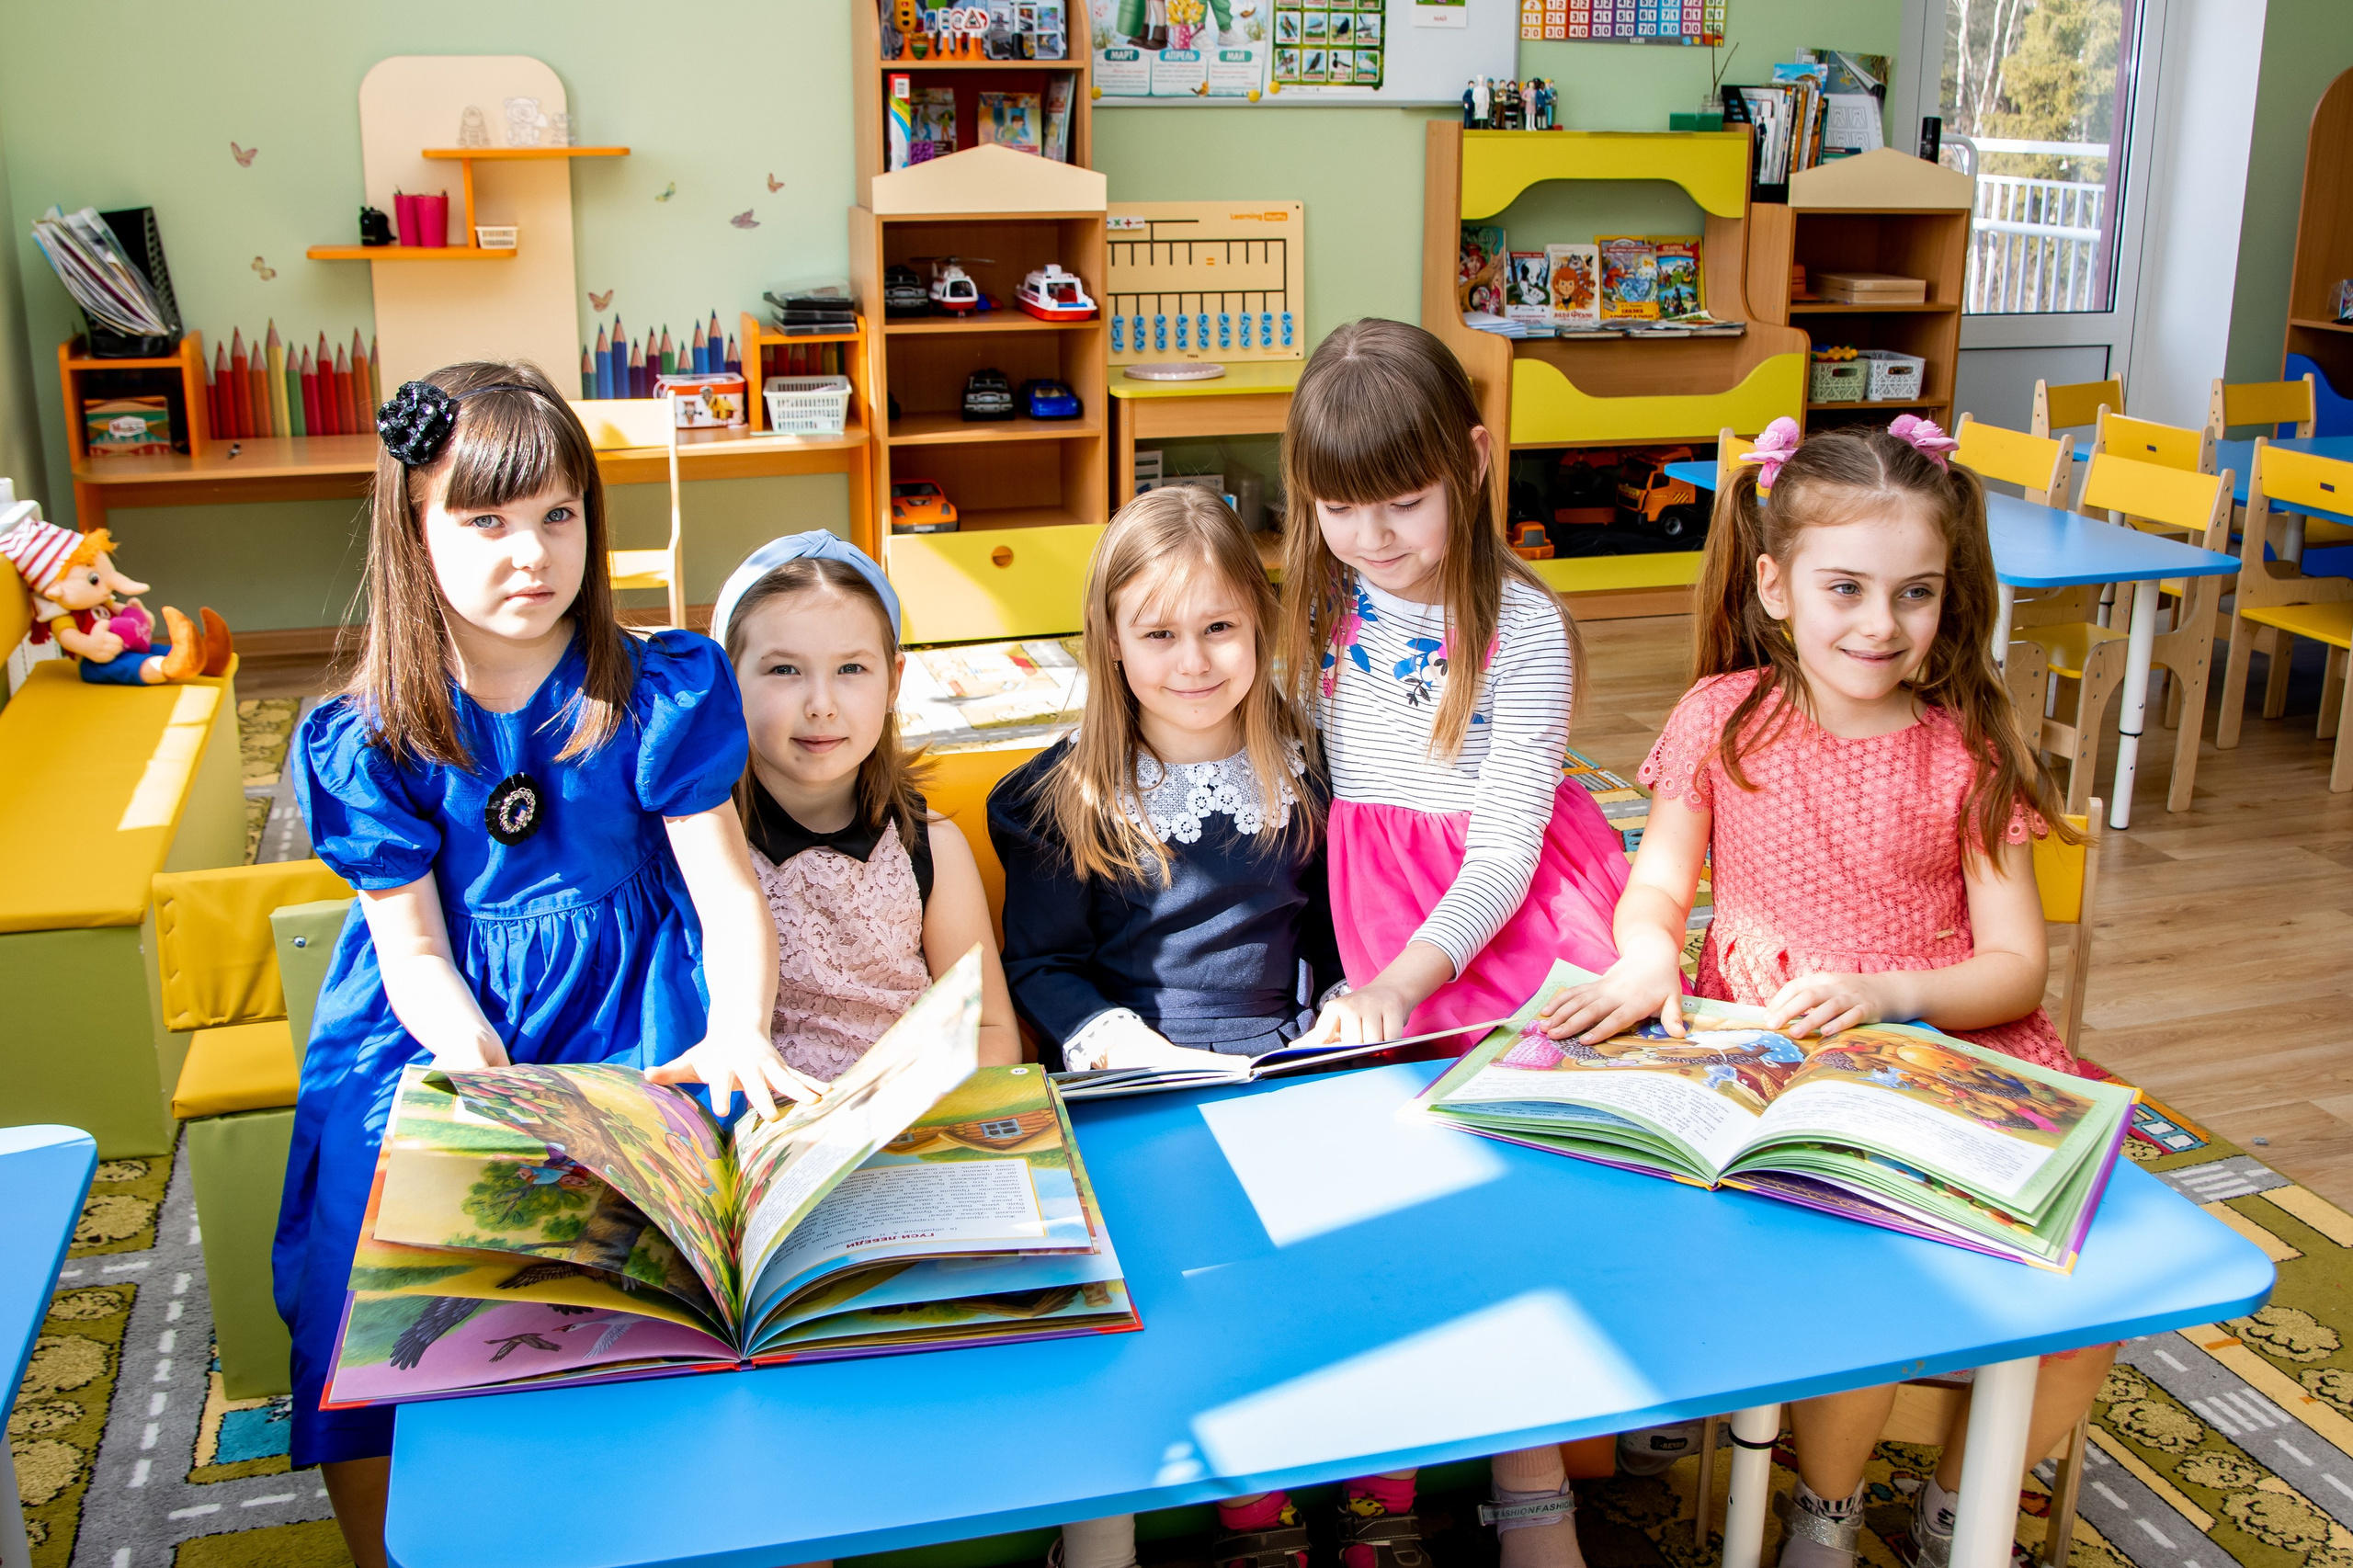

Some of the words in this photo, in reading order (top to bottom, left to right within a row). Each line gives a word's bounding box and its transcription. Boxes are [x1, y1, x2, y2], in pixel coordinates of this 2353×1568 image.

[1525, 15, 1540, 24] 11
[1548, 14, 1563, 23] 21
[1572, 13, 1586, 22] 31
[1595, 13, 1609, 21] 41
[1664, 10, 1677, 19] 71
[1523, 28, 1539, 38] 20
[1548, 28, 1563, 37] 30
[1571, 28, 1586, 36] 40
[1595, 27, 1609, 35] 50
[1640, 25, 1654, 33] 70
[1109, 50, 1133, 60] МАРТ
[1164, 51, 1197, 61] АПРЕЛЬ
[1225, 51, 1245, 61] МАЙ
[1229, 212, 1263, 222] Learning
[846, 1233, 935, 1249] ГУСИ-ЛЕБЕДИ
